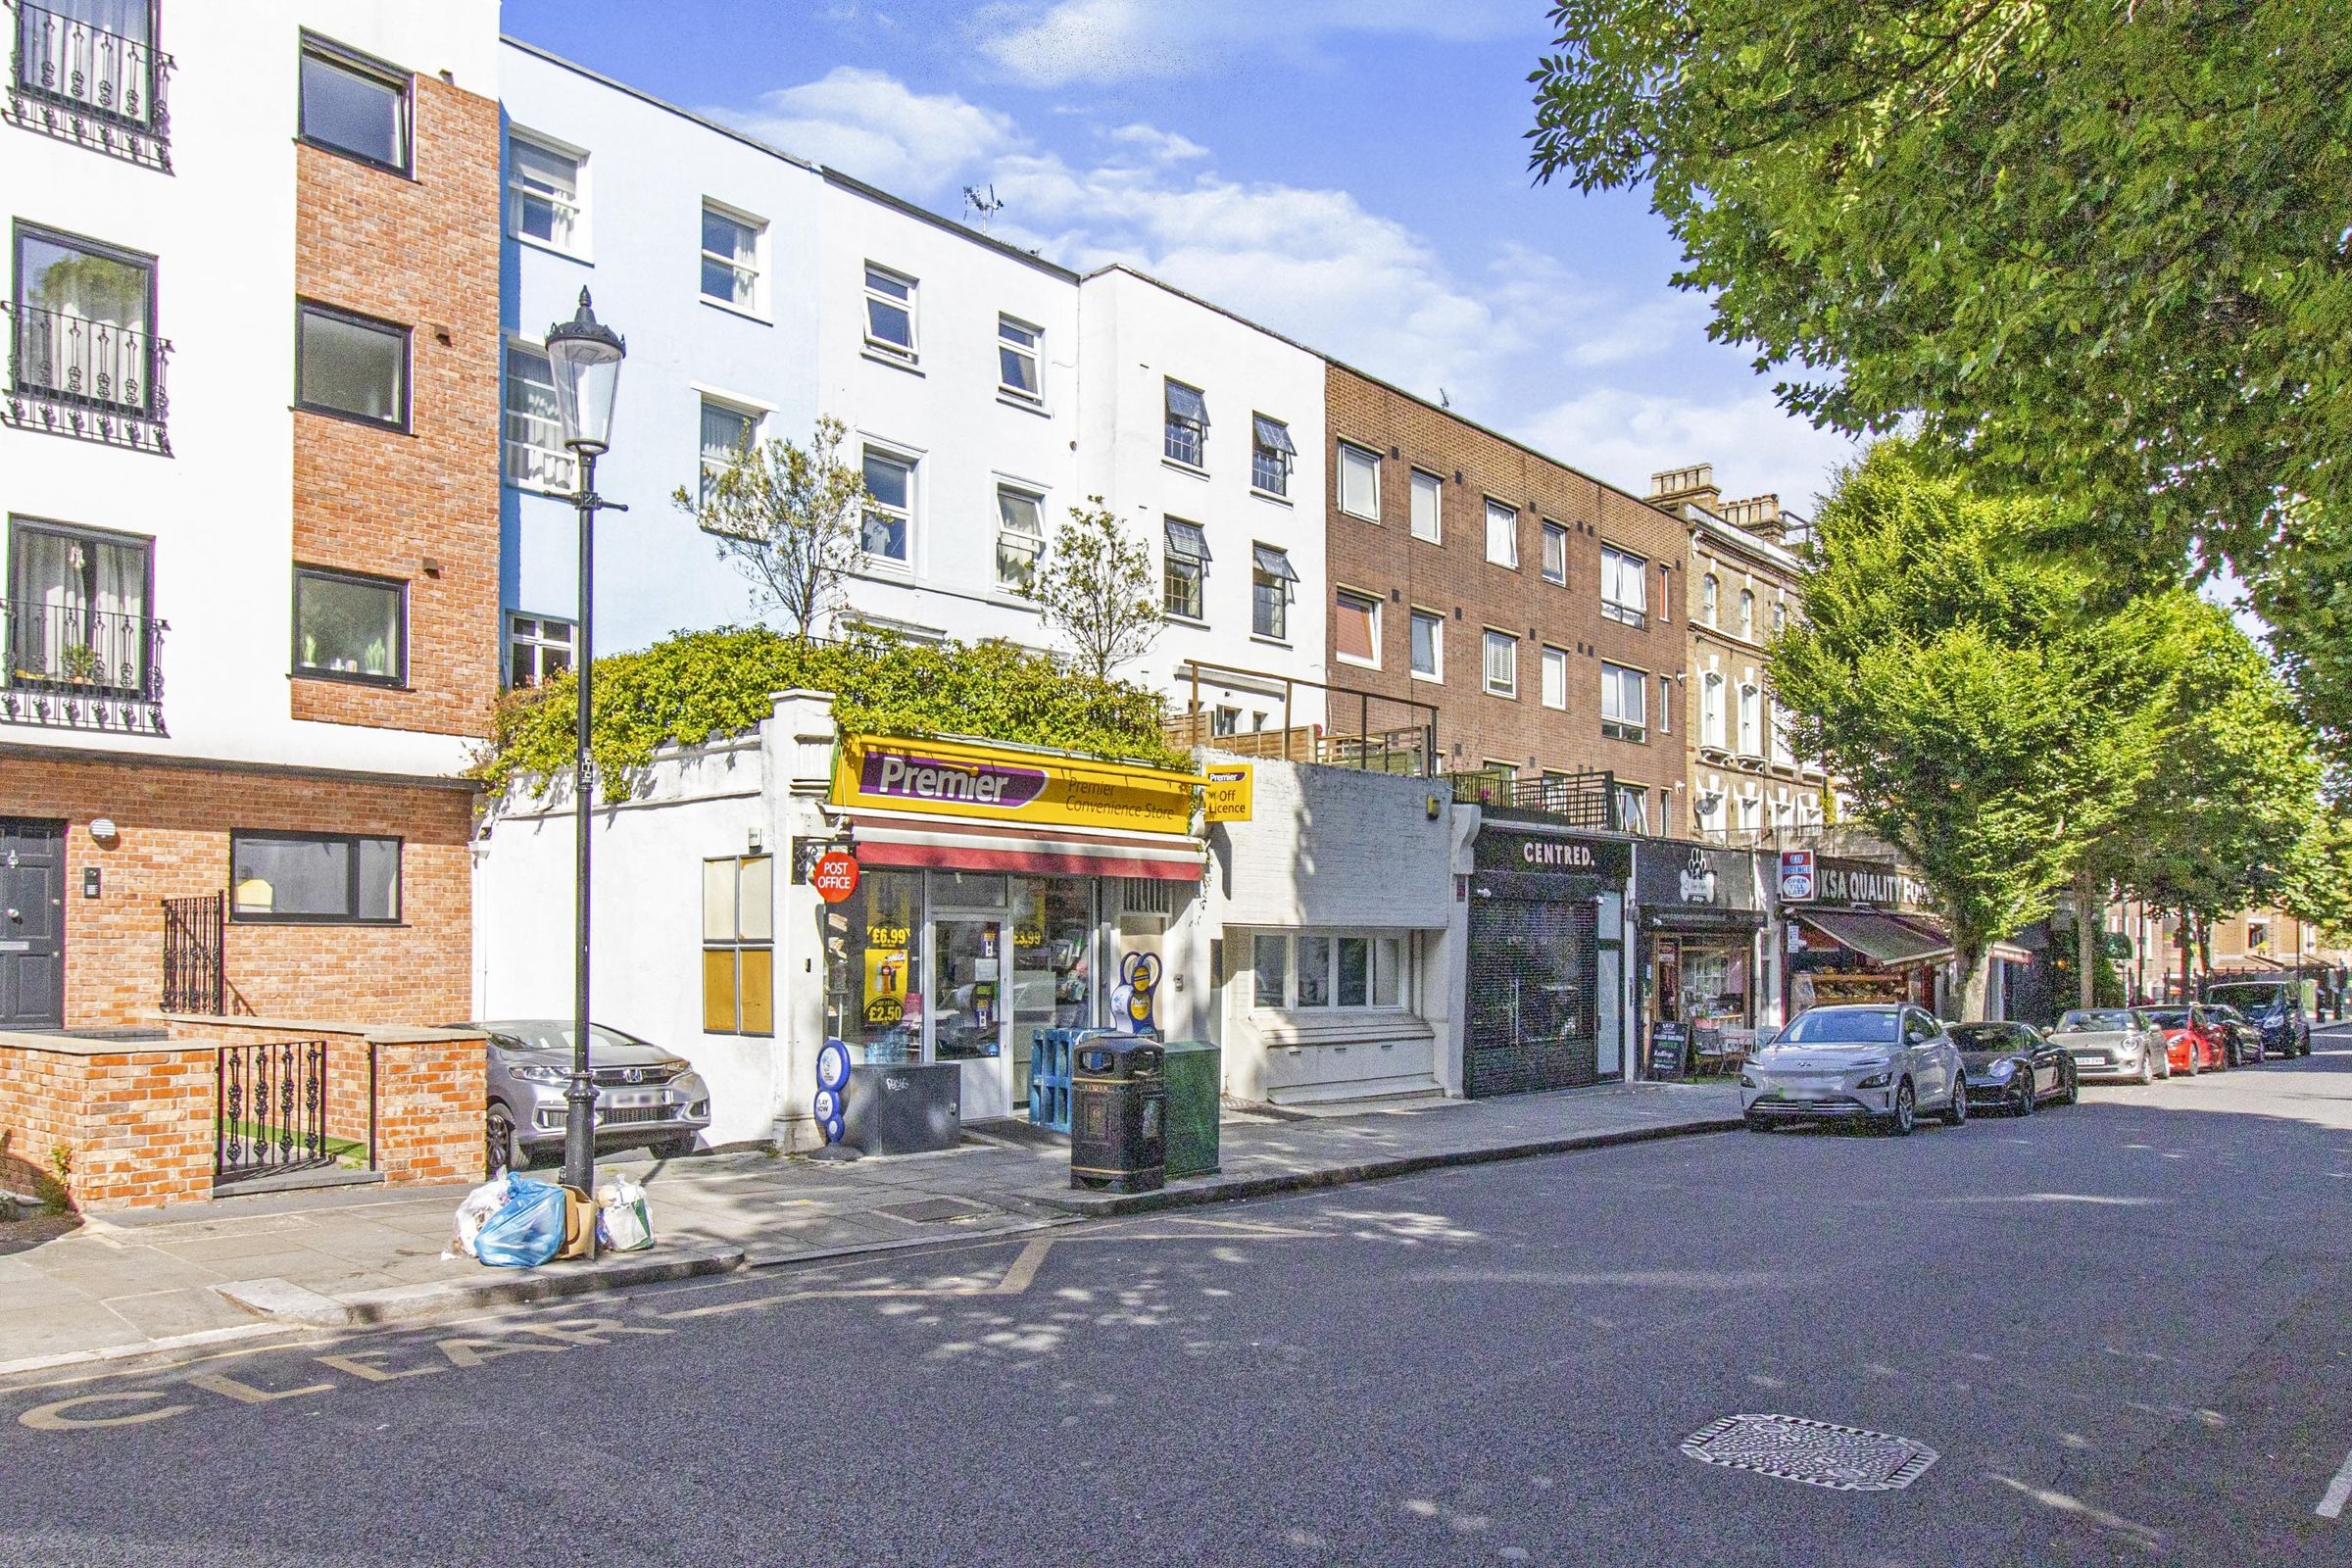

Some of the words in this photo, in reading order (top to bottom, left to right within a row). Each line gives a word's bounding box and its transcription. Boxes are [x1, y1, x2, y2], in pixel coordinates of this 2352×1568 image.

[879, 757, 1009, 803] Premier
[1209, 772, 1238, 782] Premier
[1068, 776, 1116, 797] Premier
[1219, 790, 1236, 802] Off
[1066, 795, 1141, 816] Convenience
[1145, 803, 1175, 820] Store
[1208, 803, 1246, 814] Licence
[1523, 842, 1595, 866] CENTRED.
[823, 862, 849, 875] POST
[817, 876, 851, 889] OFFICE
[1849, 871, 1901, 902] QUALITY
[872, 928, 906, 944] £6.99
[868, 1005, 902, 1022] £2.50
[17, 1318, 676, 1430] CLEAR
